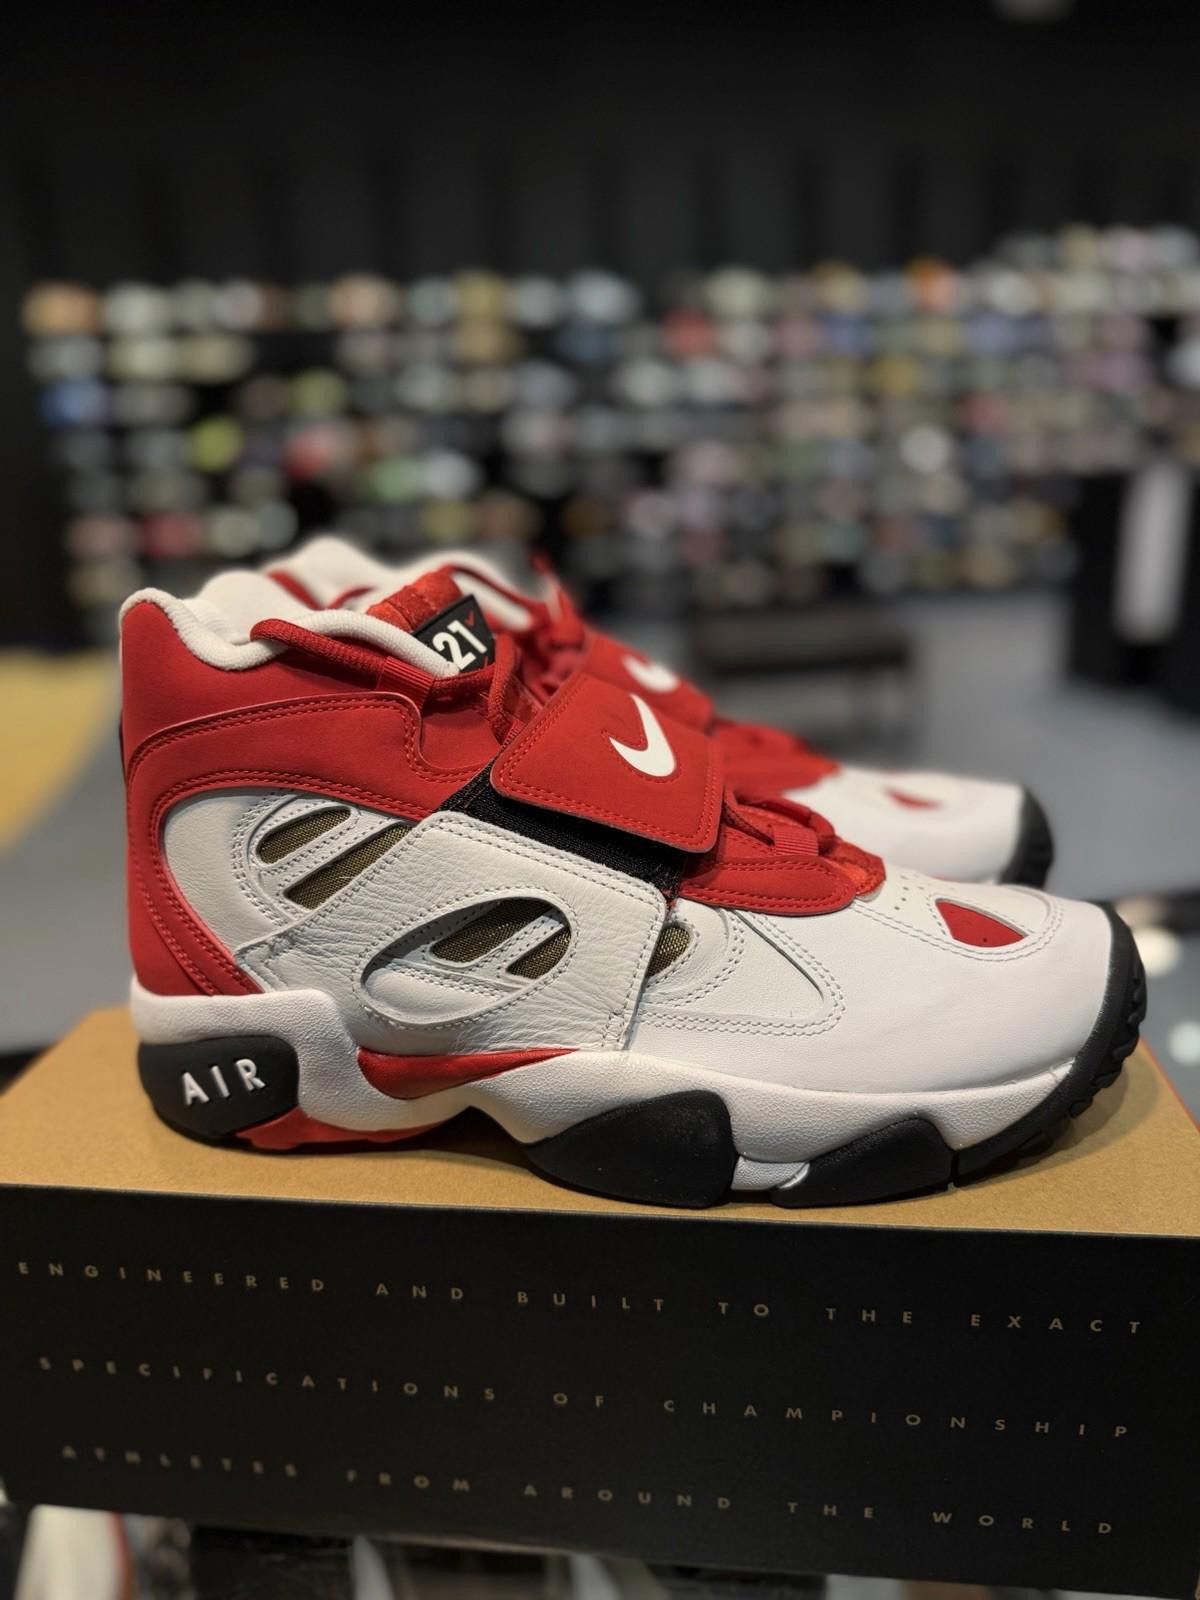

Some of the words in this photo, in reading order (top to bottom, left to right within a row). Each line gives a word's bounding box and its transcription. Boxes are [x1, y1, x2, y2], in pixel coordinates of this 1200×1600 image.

[432, 619, 488, 670] 21
[181, 1058, 267, 1106] AIR
[18, 1261, 324, 1293] ENGINEERED
[376, 1281, 464, 1301] AND
[516, 1290, 664, 1312] BUILT
[718, 1301, 769, 1318] TO
[825, 1307, 912, 1325] THE
[970, 1314, 1141, 1335] EXACT
[39, 1356, 495, 1401] SPECIFICATIONS
[552, 1392, 606, 1409] OF
[663, 1399, 1128, 1439] CHAMPIONSHIP
[62, 1445, 297, 1478] ATHLETES
[347, 1470, 470, 1493] FROM
[524, 1484, 731, 1510] AROUND
[787, 1502, 874, 1519] THE
[932, 1511, 1112, 1535] WORLD
